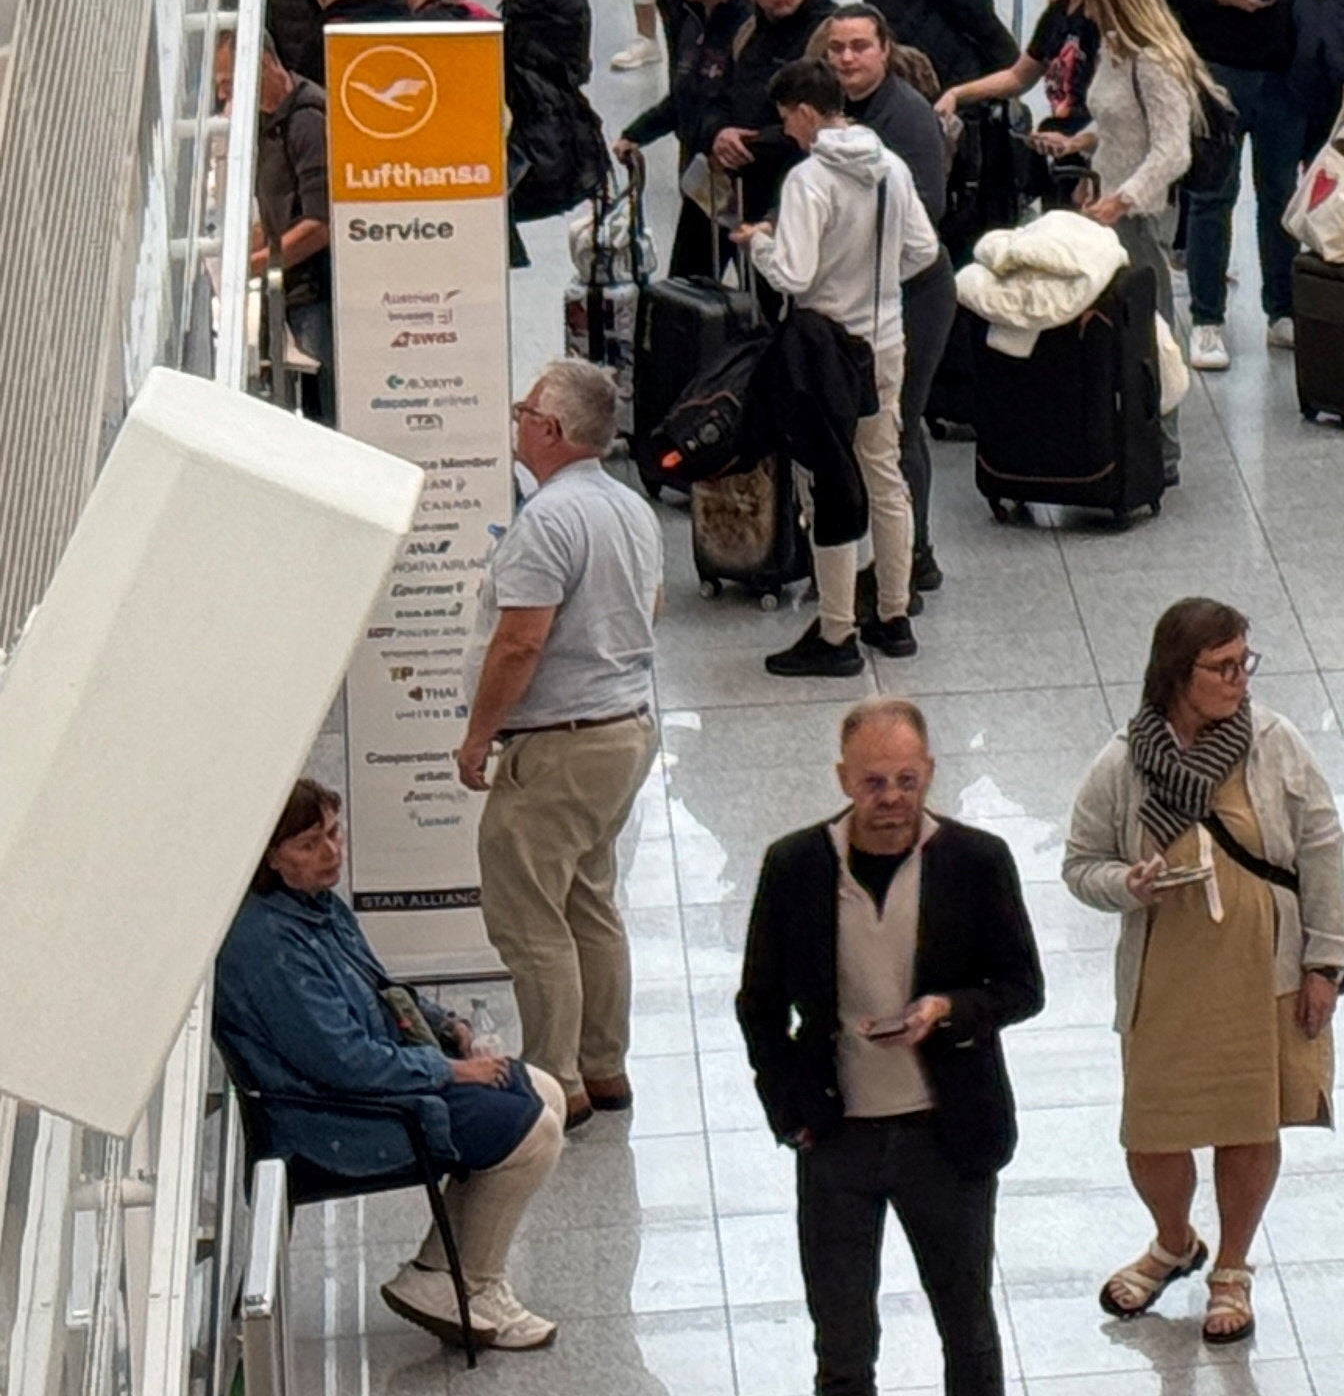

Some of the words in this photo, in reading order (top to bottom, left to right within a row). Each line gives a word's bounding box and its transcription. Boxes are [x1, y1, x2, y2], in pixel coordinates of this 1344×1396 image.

[345, 162, 491, 189] Lufthansa
[348, 217, 454, 241] Service
[420, 499, 482, 512] CANADA
[425, 688, 458, 700] THAI
[408, 889, 481, 908] ALLIANC
